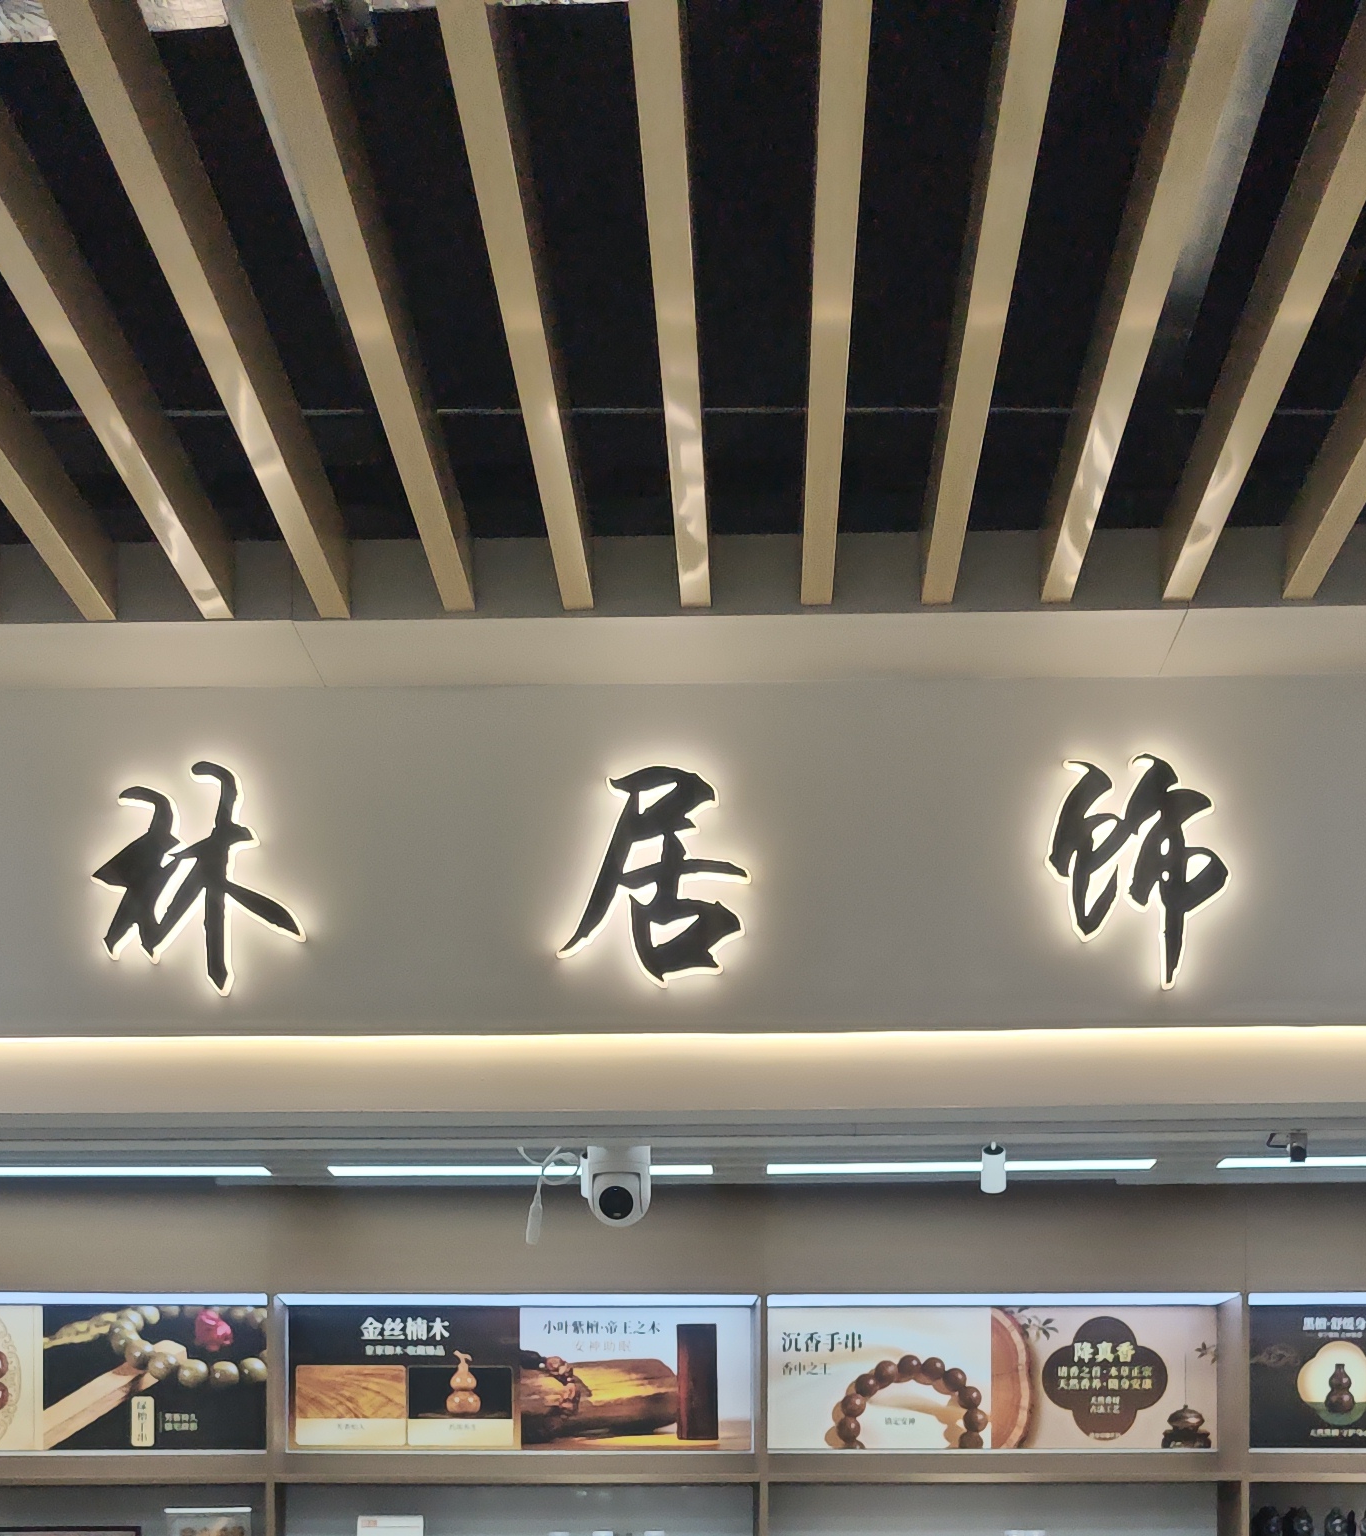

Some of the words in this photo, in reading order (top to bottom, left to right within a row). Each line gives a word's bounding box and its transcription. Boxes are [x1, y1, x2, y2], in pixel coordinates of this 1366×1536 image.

[360, 1316, 450, 1341] 金丝楠木
[781, 1331, 863, 1353] 沉香手串
[1073, 1341, 1136, 1363] 降真香
[782, 1361, 832, 1376] 香中之王
